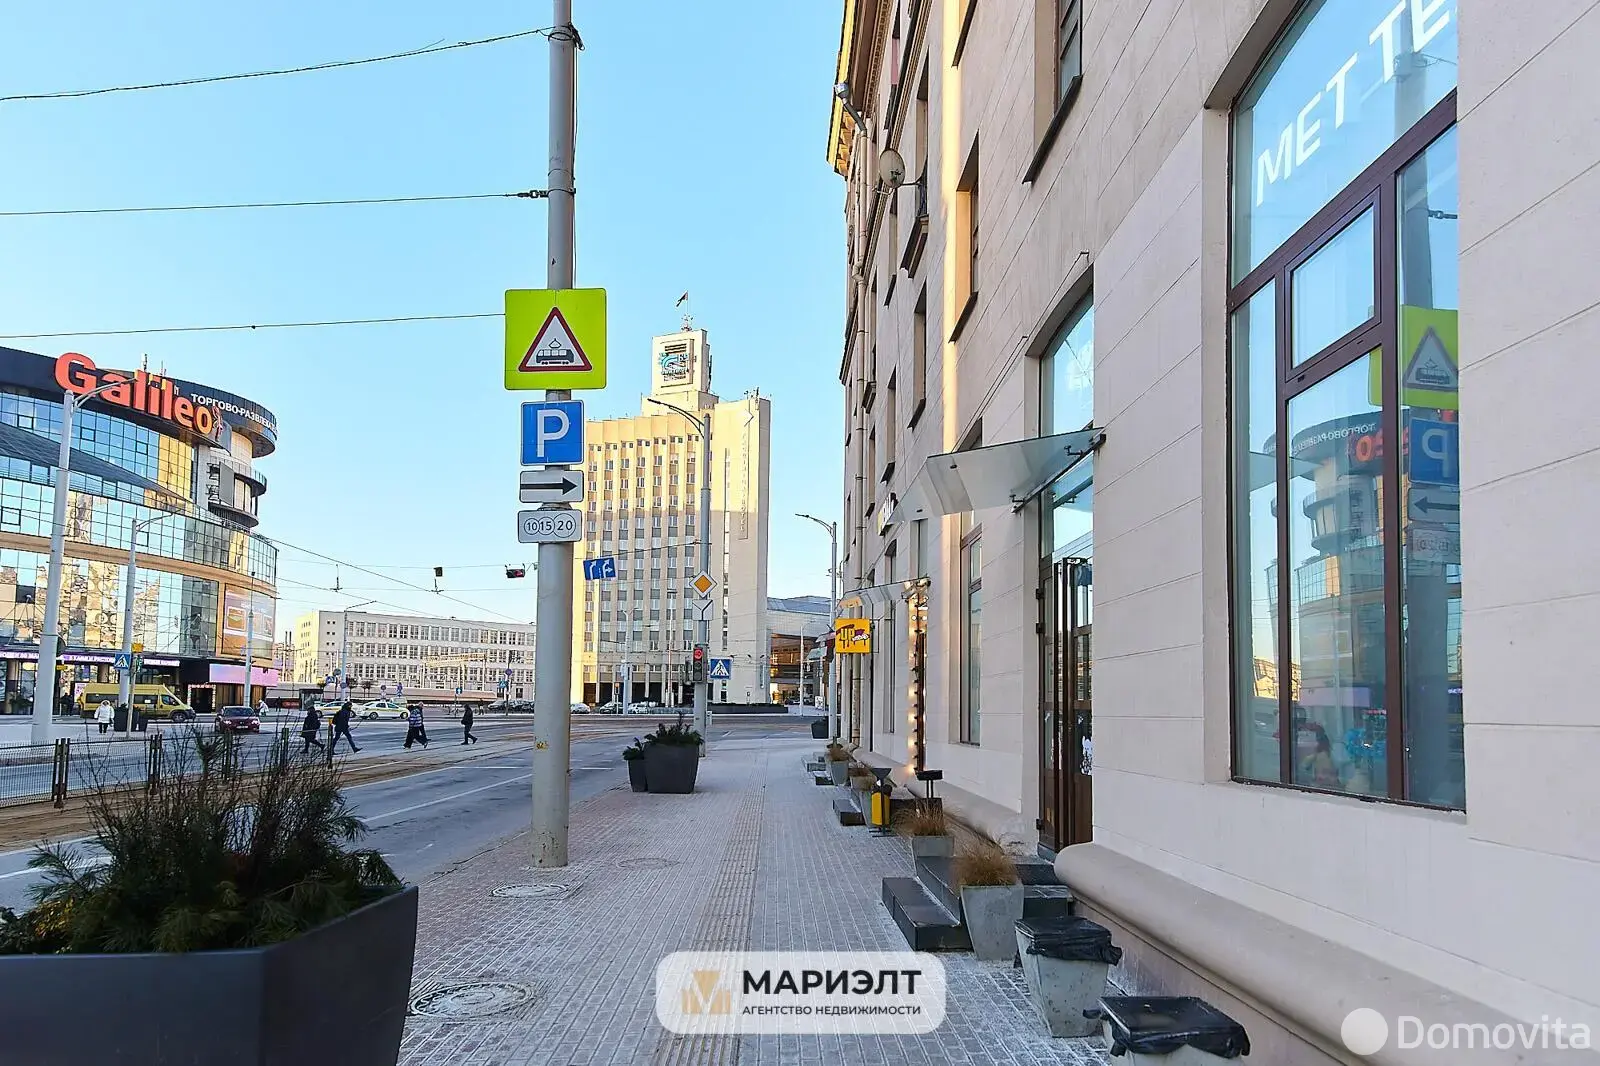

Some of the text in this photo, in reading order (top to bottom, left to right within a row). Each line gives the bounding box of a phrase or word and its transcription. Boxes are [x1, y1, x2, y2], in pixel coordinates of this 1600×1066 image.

[55, 352, 213, 434] Galileo
[537, 409, 570, 458] P
[526, 520, 573, 531] 10 15 20
